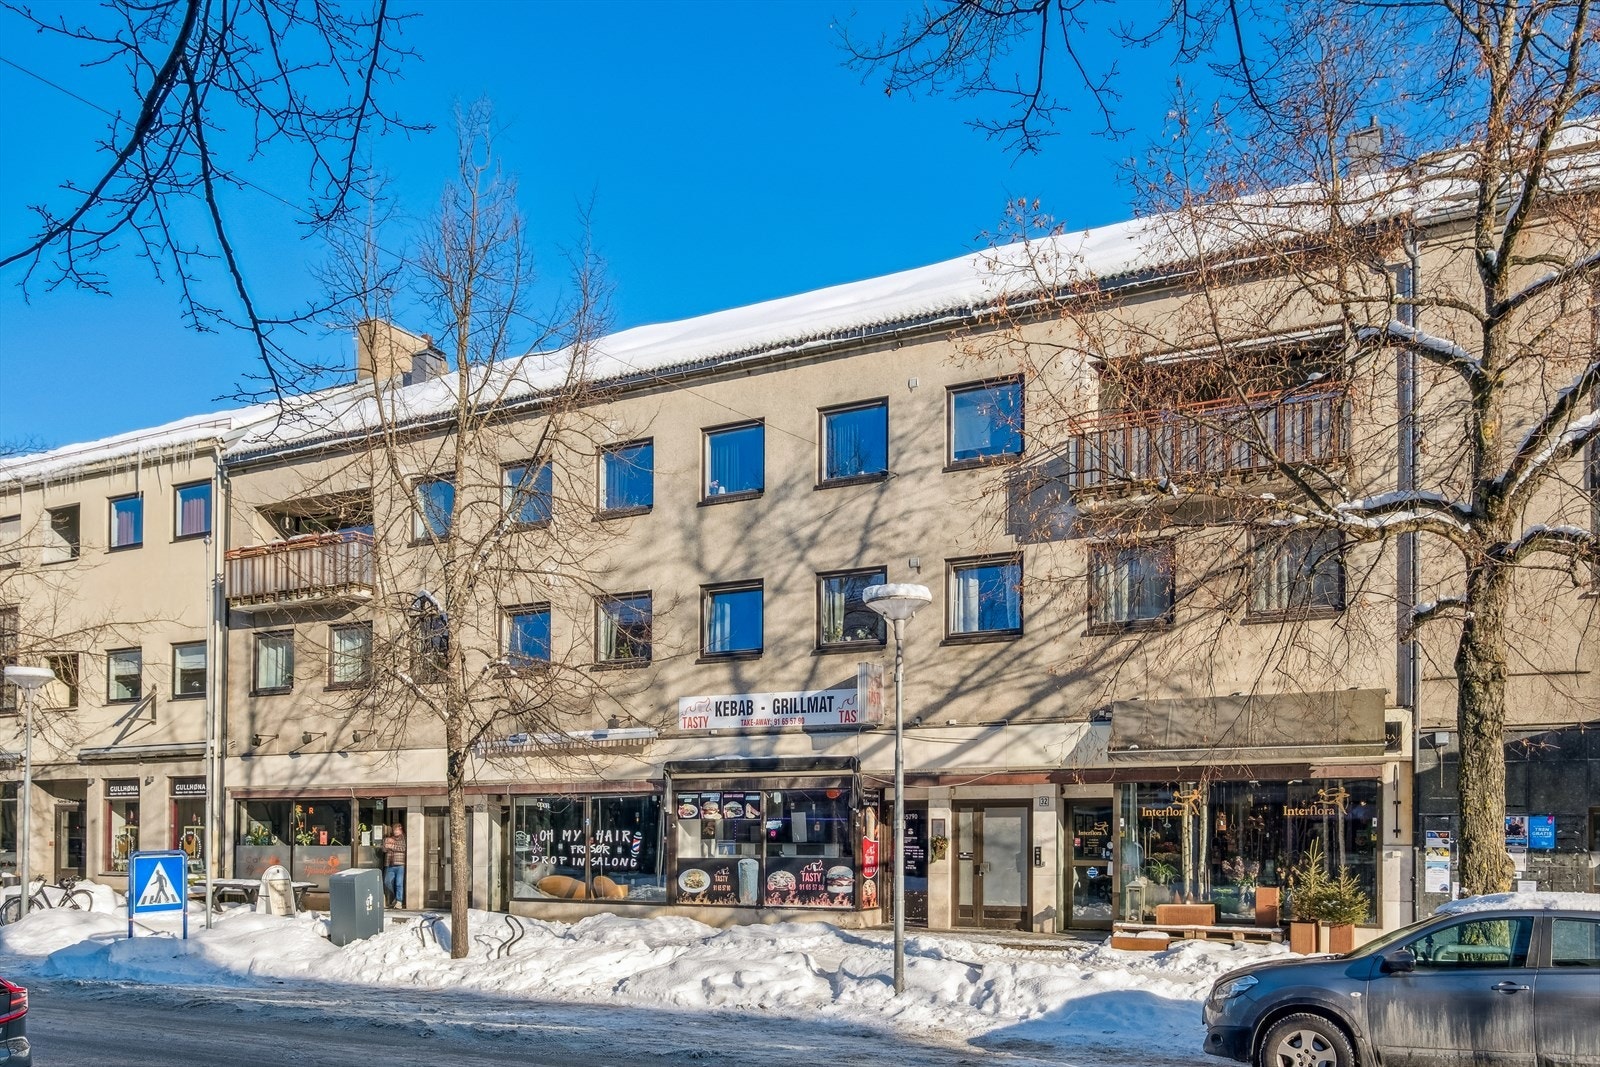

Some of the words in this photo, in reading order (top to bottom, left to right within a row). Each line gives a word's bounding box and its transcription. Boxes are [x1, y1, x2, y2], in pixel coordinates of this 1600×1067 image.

[715, 700, 754, 717] KEBAB
[772, 695, 835, 715] GRILLMAT
[682, 716, 709, 729] TASTY
[773, 718, 780, 726] 91
[789, 717, 797, 725] 57
[797, 716, 805, 725] 90
[838, 709, 859, 724] TAS
[175, 783, 206, 791] GULLHØNA
[1282, 804, 1336, 816] Interflora
[539, 829, 554, 843] OH
[562, 829, 582, 842] MY
[595, 829, 631, 843] HAIR
[531, 855, 568, 865] DROP
[572, 857, 585, 866] IN
[590, 856, 638, 867] SALONG
[801, 872, 822, 882] TASTY
